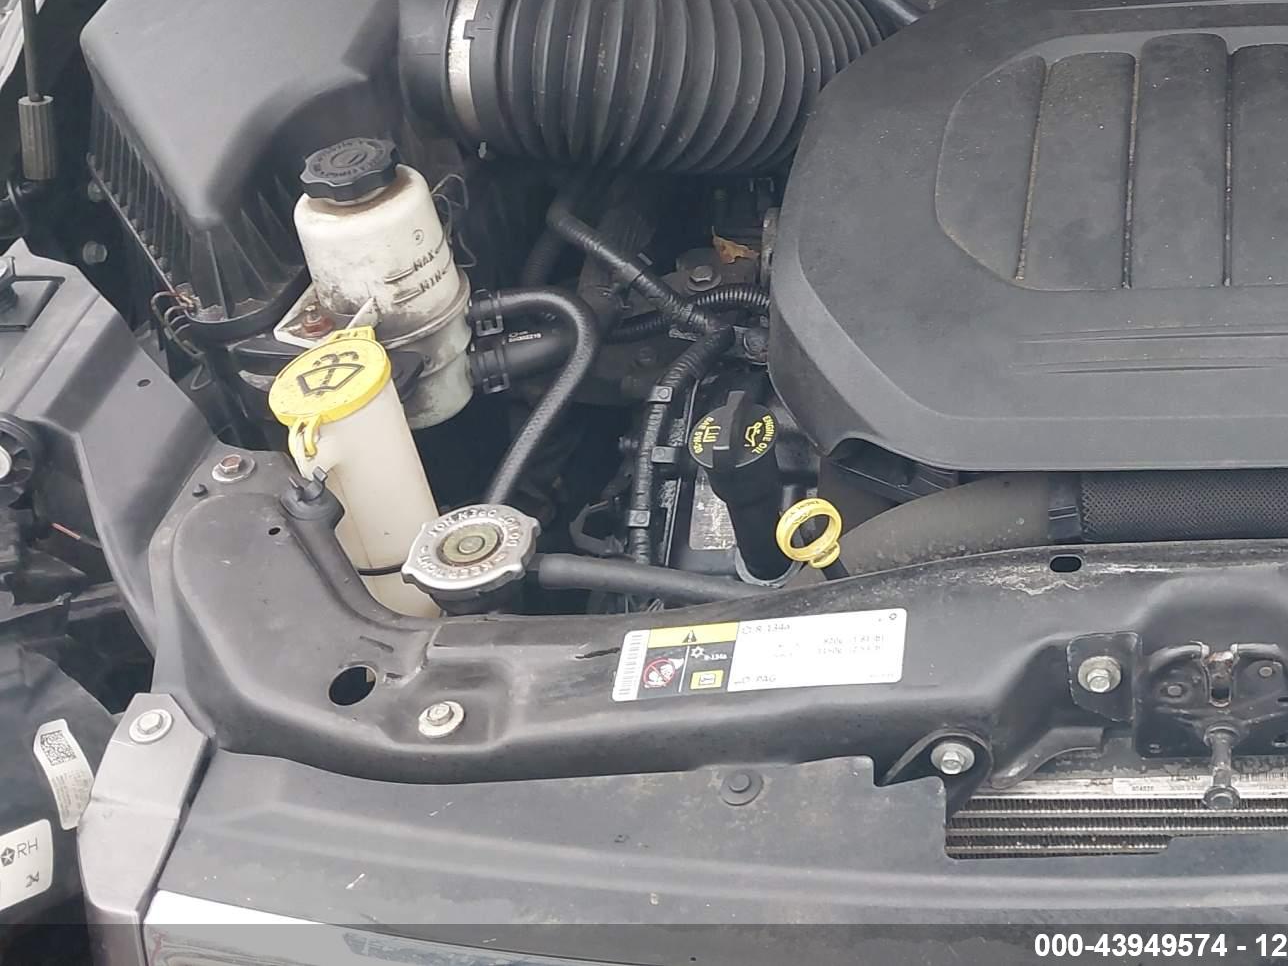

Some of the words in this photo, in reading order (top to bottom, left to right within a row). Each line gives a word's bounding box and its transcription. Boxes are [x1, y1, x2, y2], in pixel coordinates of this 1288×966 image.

[413, 249, 435, 271] MAX
[419, 270, 442, 293] MIN
[762, 415, 776, 442] ENGINE
[751, 442, 768, 455] OIL
[17, 837, 38, 858] RH
